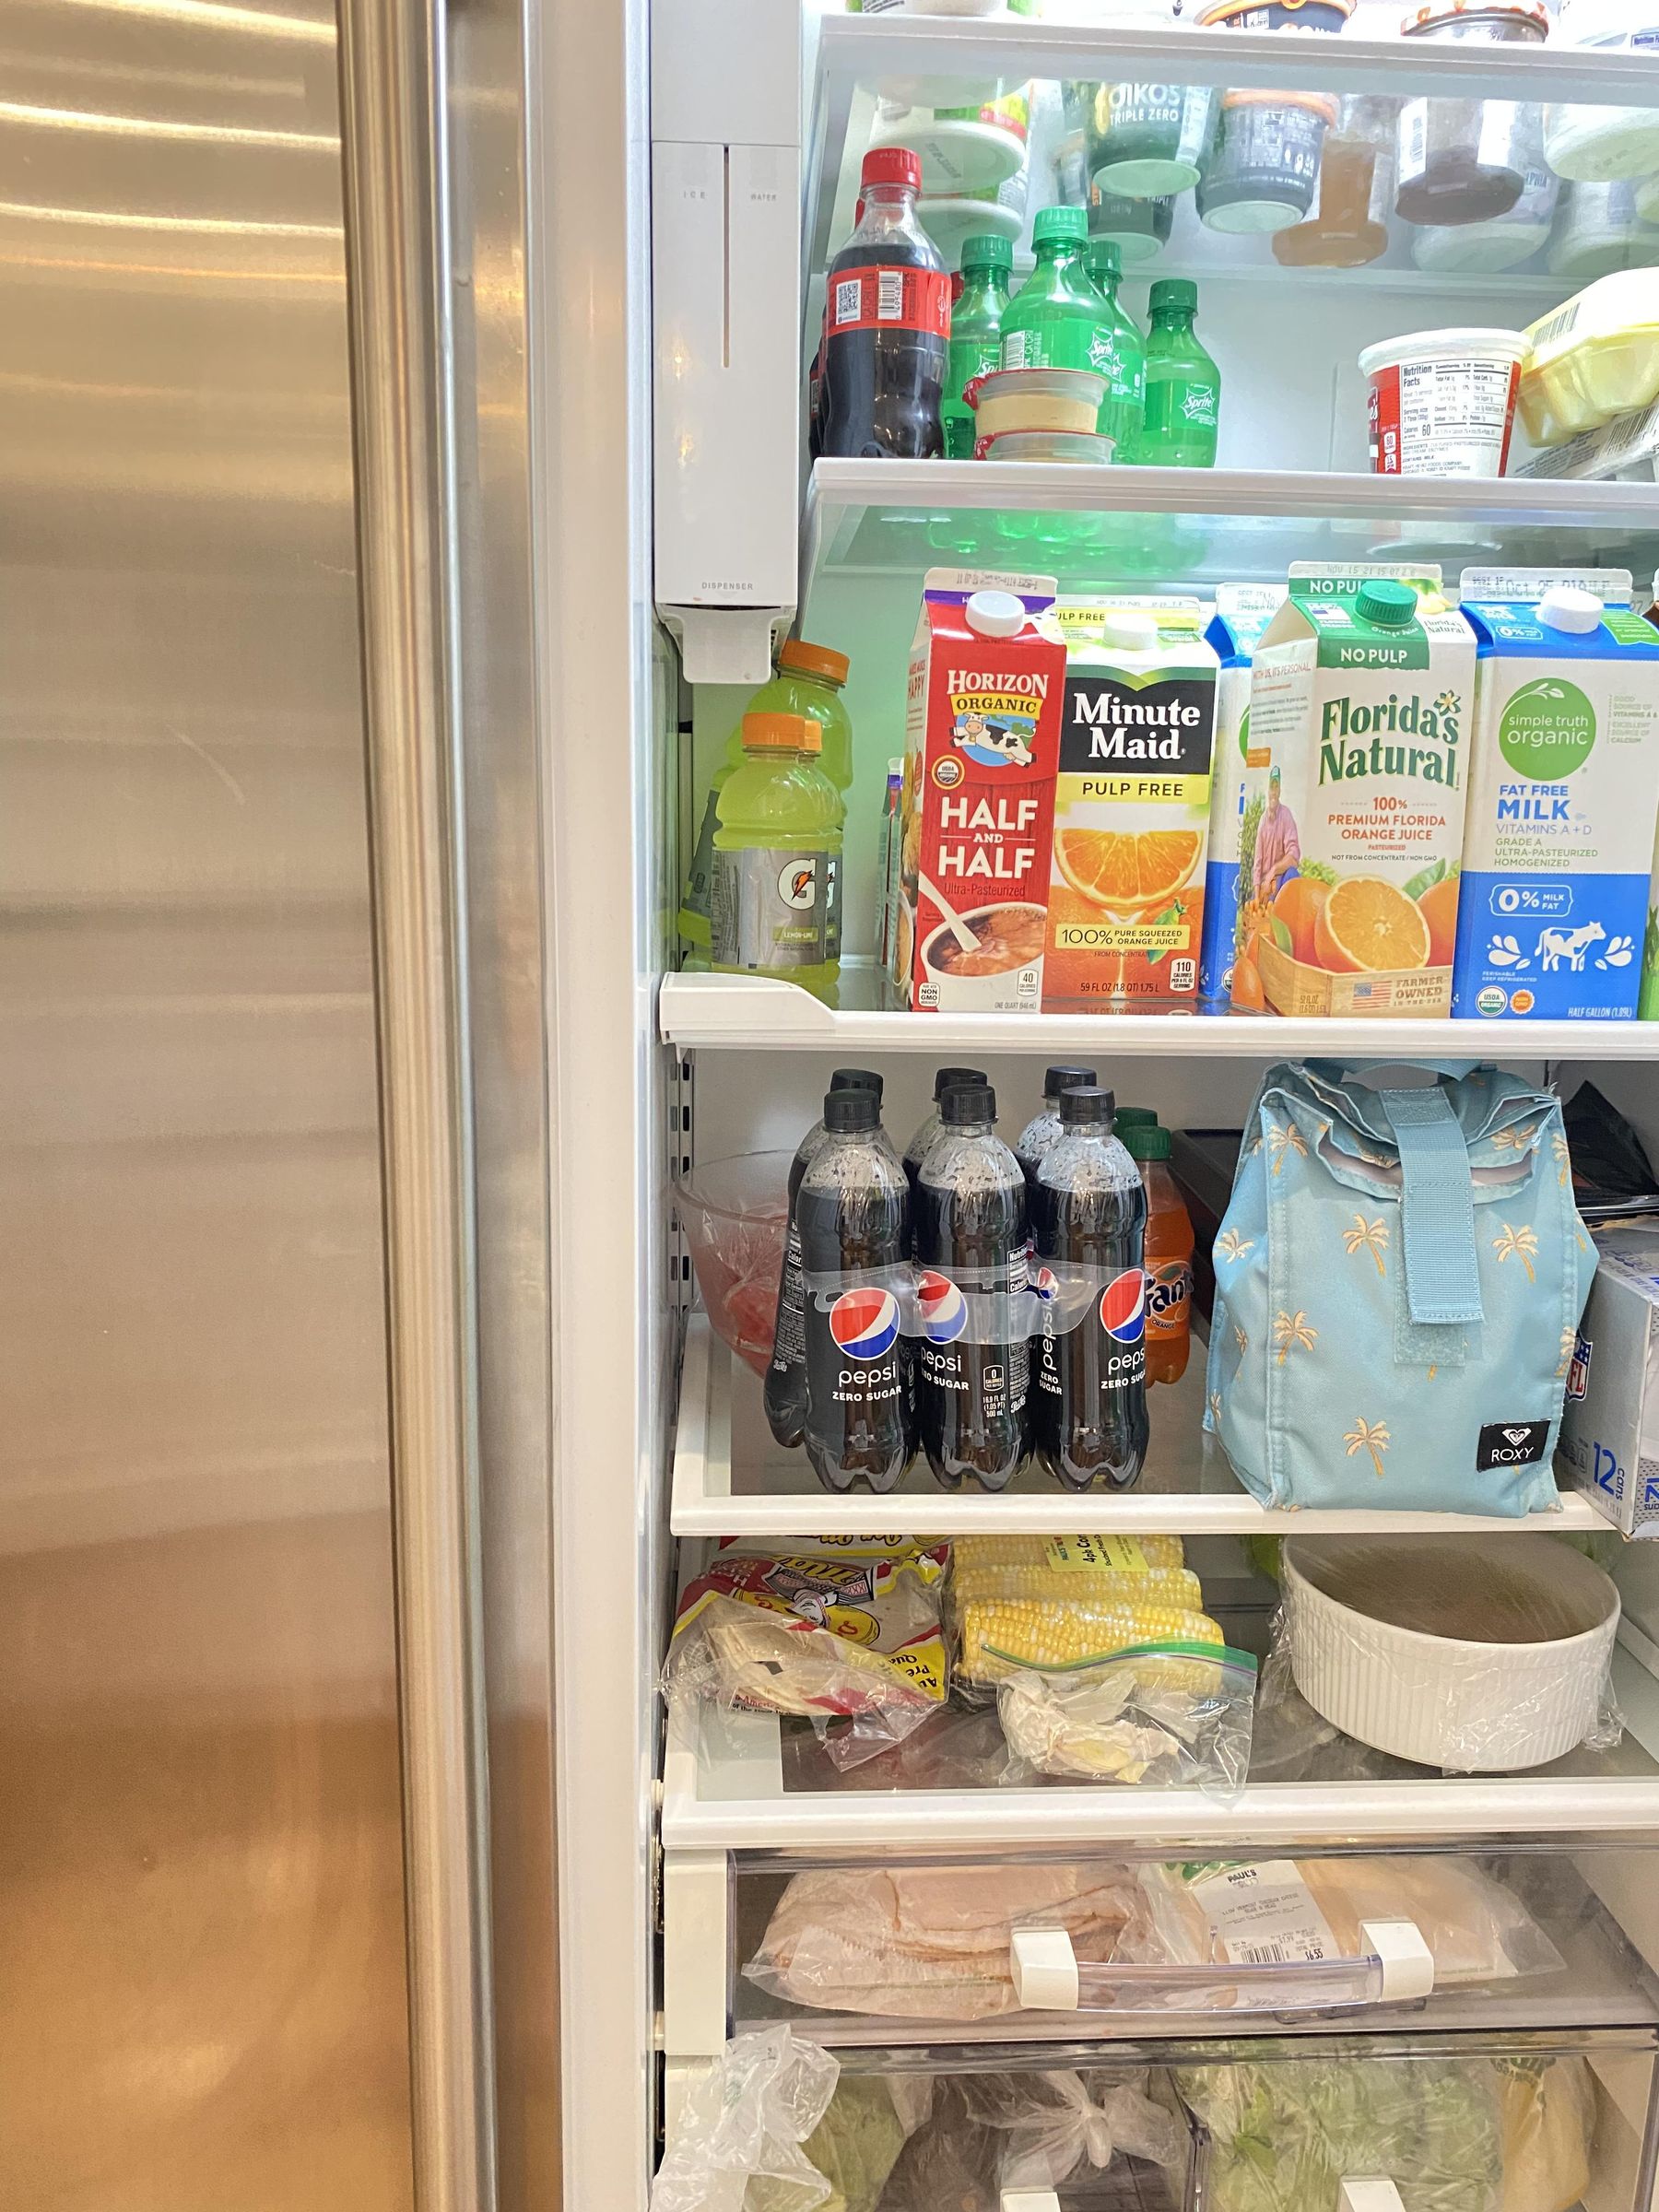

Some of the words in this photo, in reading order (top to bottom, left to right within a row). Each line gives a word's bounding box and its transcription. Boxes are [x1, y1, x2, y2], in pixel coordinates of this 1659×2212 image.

[1110, 110, 1145, 126] TRIPLE
[1147, 109, 1179, 123] ZERO
[683, 191, 706, 199] ICE
[1404, 365, 1432, 377] Nutrition
[1404, 377, 1420, 387] Facts
[1186, 395, 1214, 409] Sprite
[1422, 424, 1431, 436] 60
[701, 582, 754, 591] DISPENSER
[1310, 581, 1334, 594] NO
[1337, 580, 1362, 594] PUL
[1079, 613, 1105, 621] FREE
[1428, 626, 1465, 635] Natural
[1340, 649, 1365, 662] NO
[1369, 649, 1407, 663] PULP
[947, 669, 1050, 699] HORIZON
[956, 696, 1038, 714] ORGANIC
[1073, 692, 1201, 726] Minute
[1320, 694, 1459, 745] Florida's
[1509, 714, 1553, 730] simple
[1556, 715, 1589, 726] truth
[1088, 726, 1182, 759] Maid
[1507, 728, 1588, 747] organic
[1318, 738, 1455, 787] Natural
[1083, 782, 1131, 796] PULP
[1138, 782, 1183, 797] FREE
[1500, 785, 1527, 795] FAT
[1532, 785, 1569, 795] FREE
[1373, 796, 1407, 811] 100%
[1498, 799, 1571, 820] MILK
[940, 796, 1039, 830] HALF
[1328, 814, 1389, 825] PREMIUM
[1393, 816, 1446, 826] FLORIDA
[1341, 830, 1395, 840] ORANGE
[1397, 830, 1432, 841] JUICE
[1496, 824, 1557, 835] VITAMINS
[1560, 825, 1570, 834] A
[1583, 825, 1592, 835] D
[972, 832, 1005, 844] AND
[1496, 838, 1532, 846] GRADE
[1495, 848, 1598, 857] ULTRA-PASTEURIZED
[937, 845, 1035, 878] HALF
[1494, 859, 1570, 867] HOMOGENIZED
[777, 858, 817, 911] G
[944, 883, 1026, 897] Ultra-Pasteurized
[1499, 888, 1540, 912] 0%
[1062, 929, 1112, 945] 100%
[1177, 962, 1191, 971] 110
[1023, 973, 1033, 983] 40
[1396, 976, 1444, 987] FARMER
[1080, 983, 1090, 992] 59
[1091, 983, 1100, 992] FL
[1101, 983, 1112, 992] OZ
[1395, 987, 1442, 999] OWNED
[1568, 1007, 1584, 1017] HALF
[1585, 1007, 1610, 1018] GALLON
[1152, 1319, 1175, 1329] ORANGE
[1108, 1347, 1145, 1375] peps
[838, 1361, 896, 1388] pepsi
[991, 1370, 996, 1378] 0
[1041, 1371, 1059, 1384] ZERO
[1569, 1359, 1583, 1393] FL
[934, 1375, 970, 1391] SUGAR
[1040, 1382, 1063, 1395] SUGAR
[1100, 1378, 1128, 1390] ZERO
[832, 1392, 863, 1402] ZERO
[865, 1385, 902, 1401] SUGAR
[982, 1394, 993, 1404] 16.9
[1491, 1447, 1534, 1463] ROXY
[1593, 1441, 1617, 1495] 12
[1616, 1468, 1625, 1500] cans
[1081, 1548, 1097, 1563] 4pk
[1228, 1869, 1257, 1883] PAUL'S
